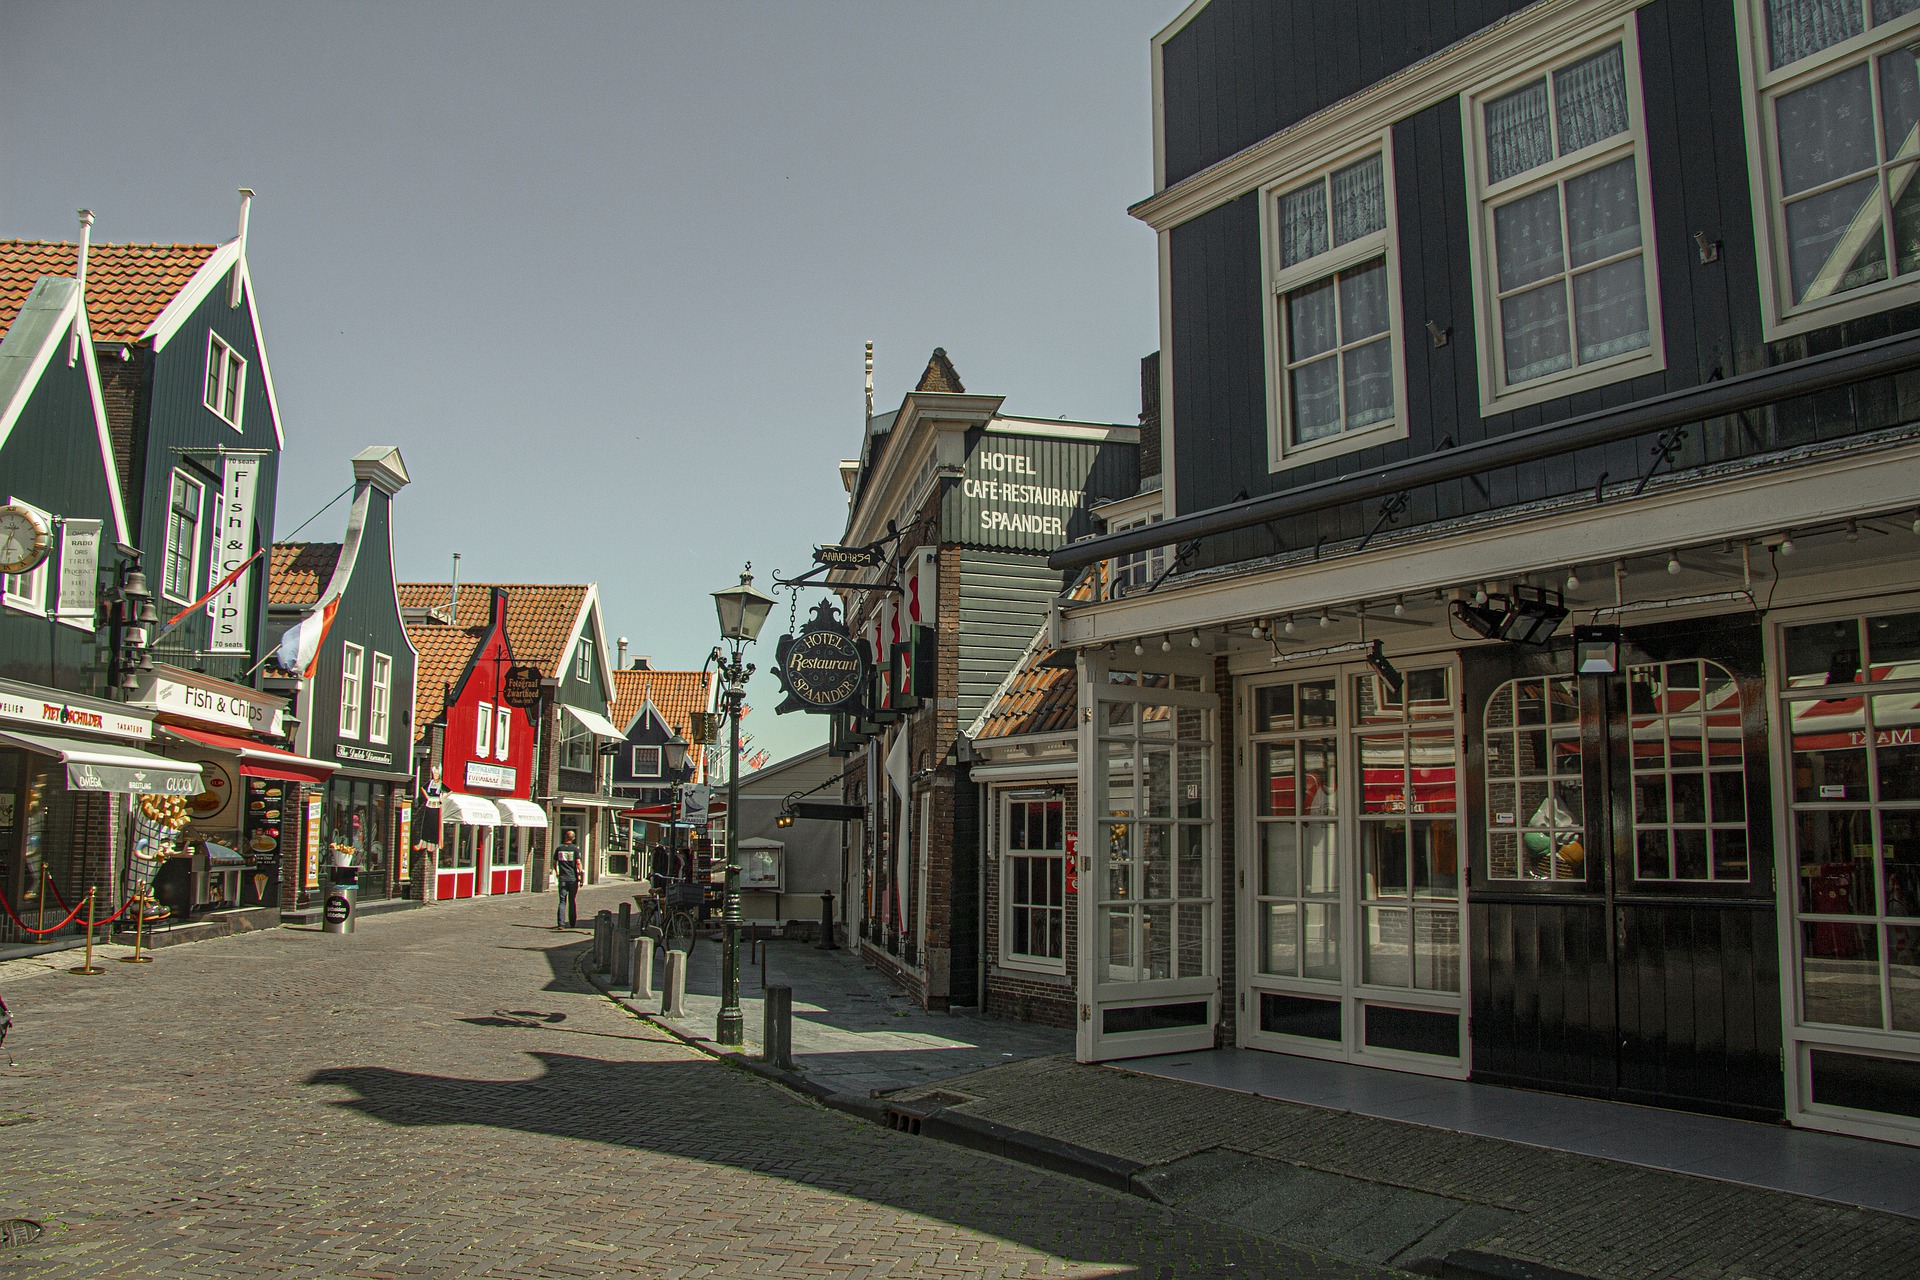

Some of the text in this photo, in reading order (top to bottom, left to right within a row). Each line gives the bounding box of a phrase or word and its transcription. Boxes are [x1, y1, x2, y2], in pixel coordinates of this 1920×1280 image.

[981, 451, 1037, 475] HOTEL
[229, 471, 248, 528] Fish
[963, 478, 1087, 509] CAFÉ-RESTAURANT
[980, 510, 1067, 536] SPAANDER.
[803, 633, 843, 650] HOTEL
[790, 653, 858, 672] Restaurant
[509, 679, 539, 690] Fotograaf
[793, 678, 854, 704] SPAANDER
[185, 685, 213, 710] Fish
[217, 697, 226, 713] &
[230, 698, 263, 721] Chips
[42, 703, 61, 721] PIET
[68, 710, 103, 729] SCHILDER
[80, 777, 193, 792] OMEGA BREITLING GUCCI
[1188, 785, 1197, 798] 21
